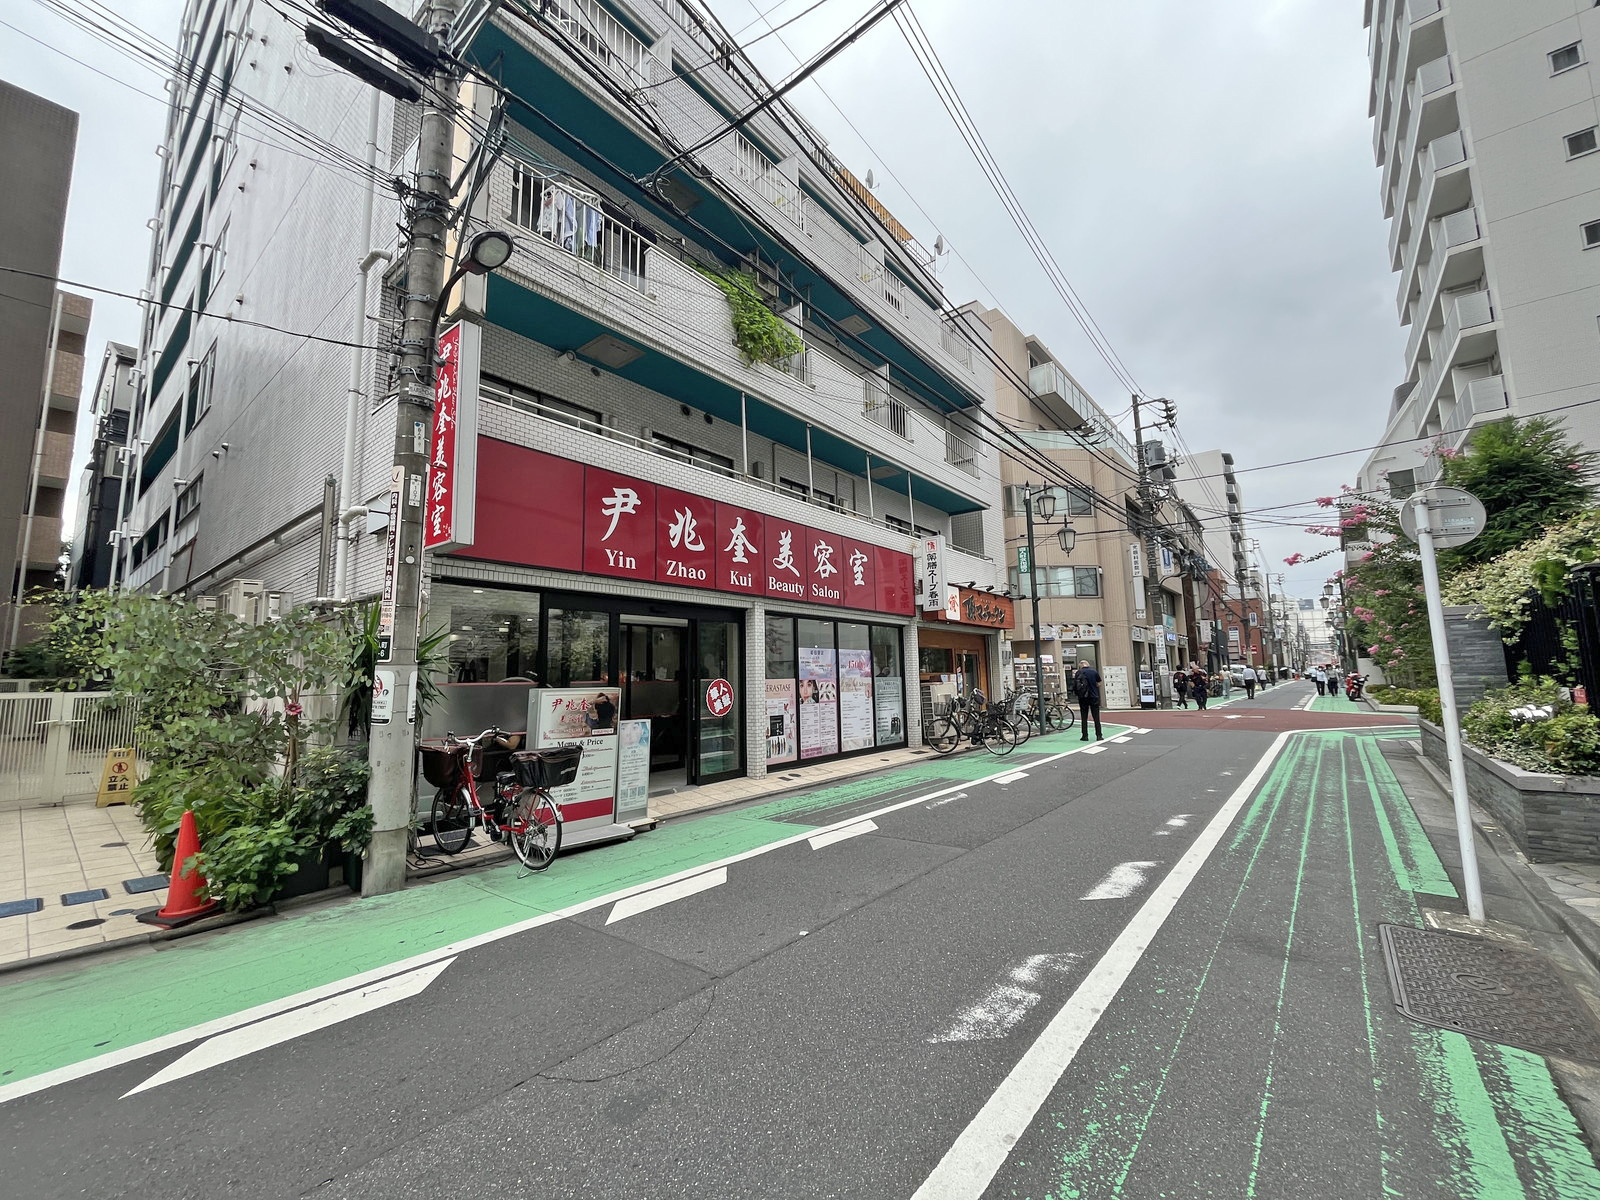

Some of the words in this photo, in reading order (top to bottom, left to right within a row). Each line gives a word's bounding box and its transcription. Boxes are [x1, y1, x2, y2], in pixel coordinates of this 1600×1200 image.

[601, 487, 868, 586] 尹兆奎美容室
[604, 549, 637, 570] Yin
[666, 560, 706, 581] Zhao
[730, 570, 753, 588] Kui
[768, 576, 805, 597] Beauty
[811, 583, 840, 600] Salon
[108, 775, 129, 784] 立入
